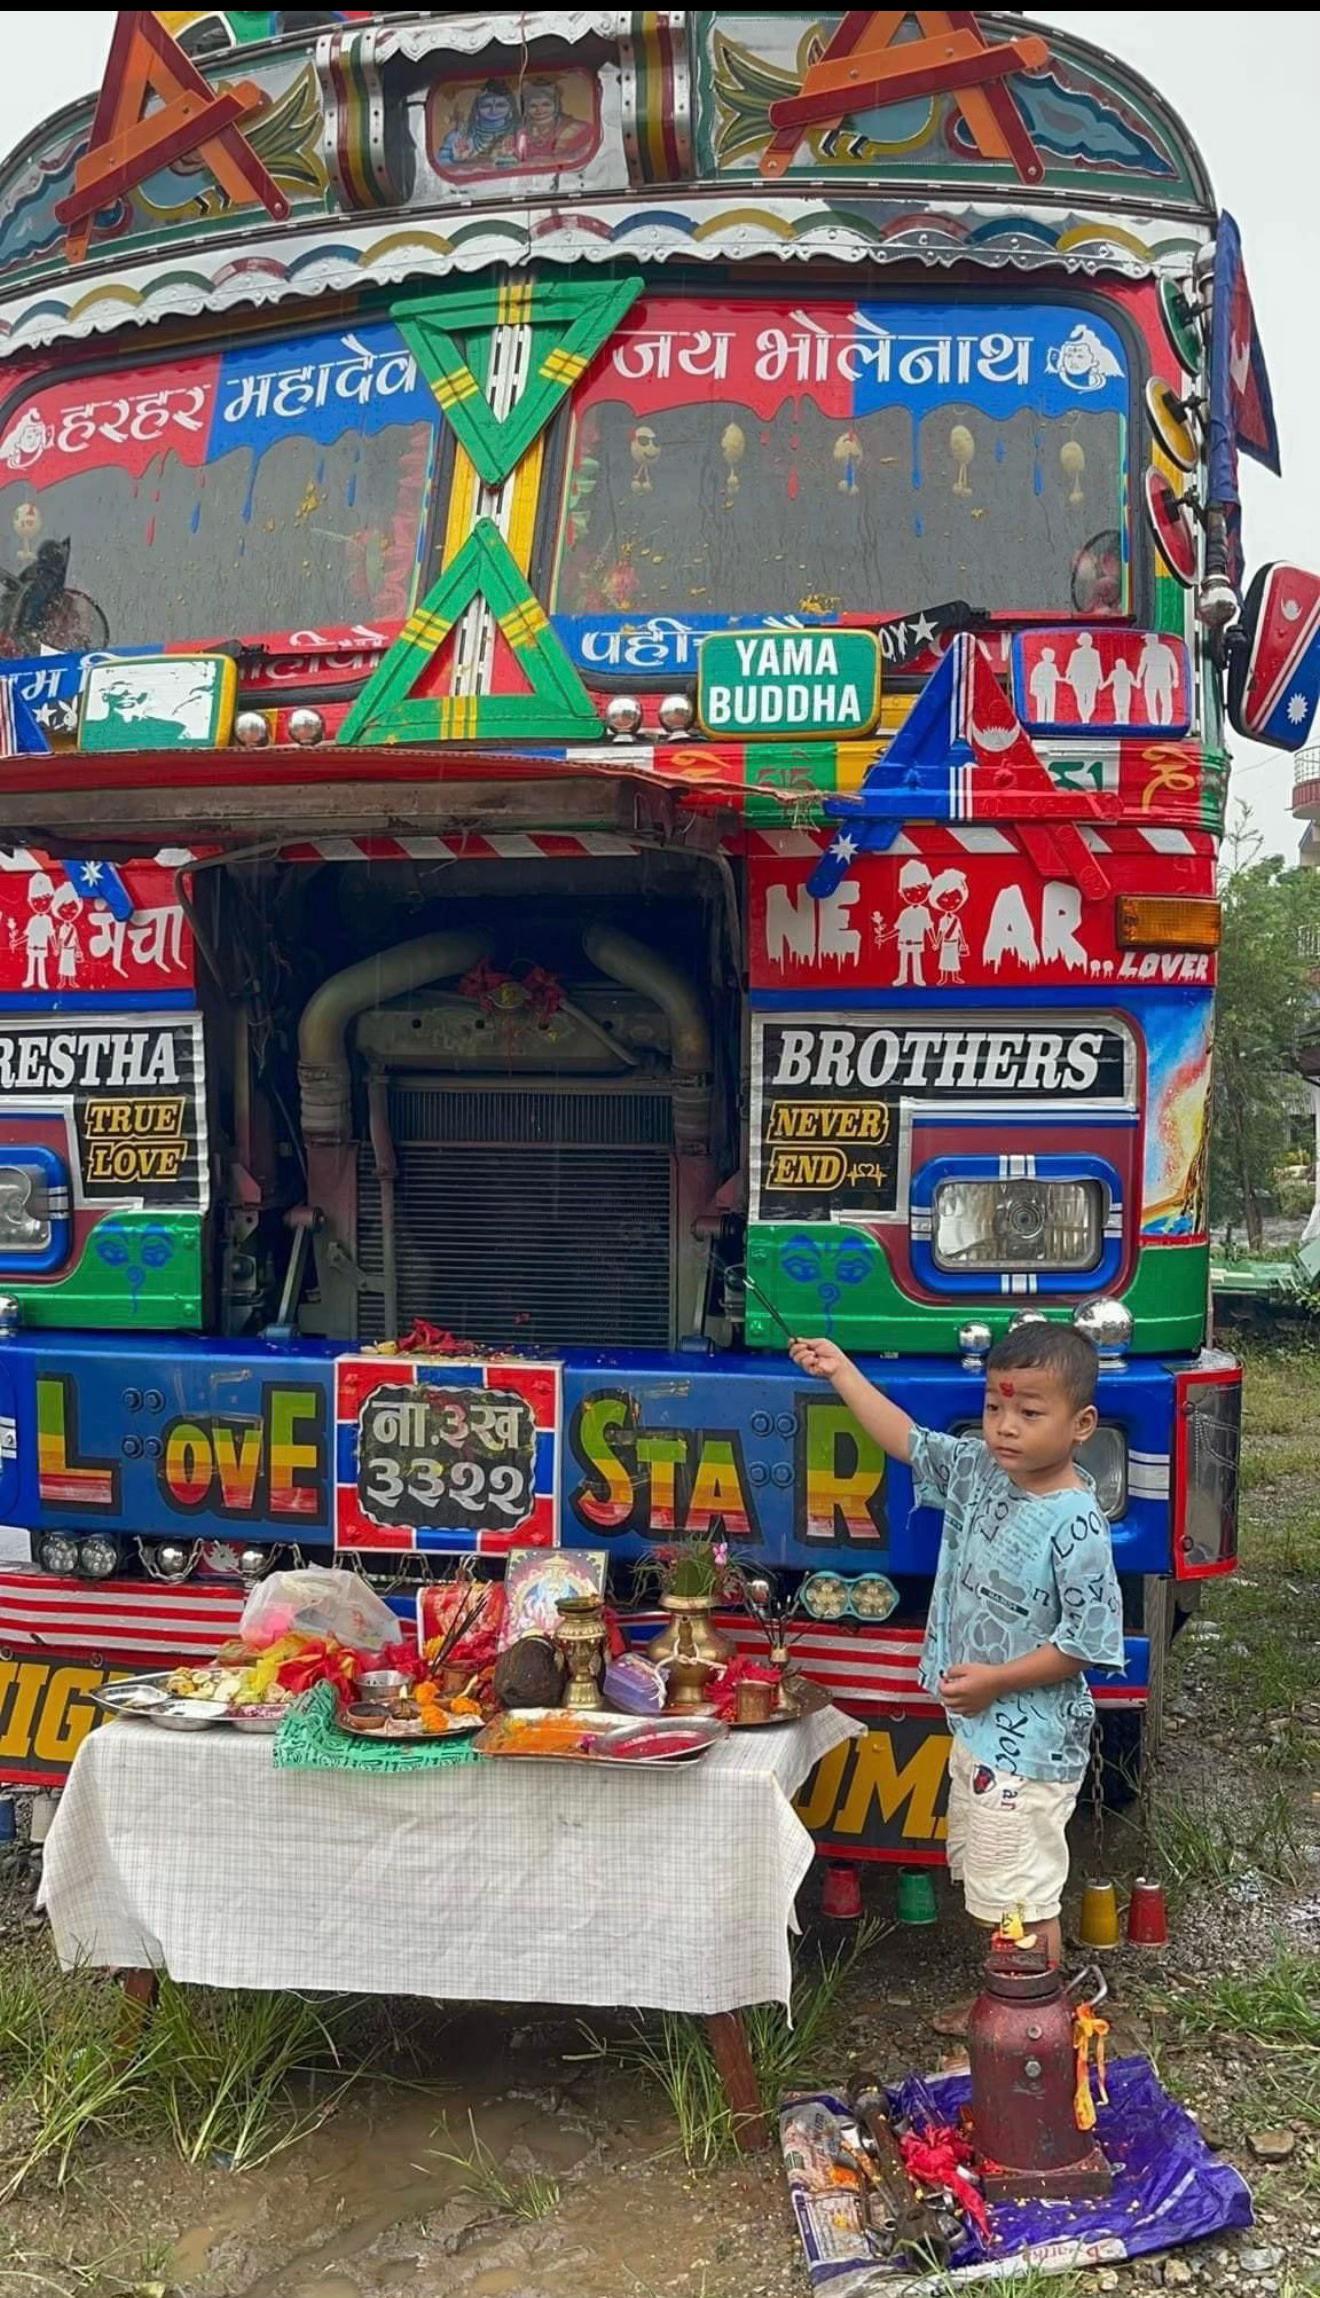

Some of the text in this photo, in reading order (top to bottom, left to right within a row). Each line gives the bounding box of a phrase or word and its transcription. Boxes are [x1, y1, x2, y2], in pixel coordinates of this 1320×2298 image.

[611, 310, 1035, 386] जय भोलेनाथ
[223, 333, 418, 423] महादेव
[734, 638, 839, 677] YAMA
[708, 684, 861, 724] BUDDHA
[1116, 951, 1209, 981] LOVER
[772, 1029, 1103, 1091] BROTHERS
[89, 1104, 178, 1134] TRUE
[772, 1107, 883, 1139] NEVER
[92, 1148, 181, 1177] LOVE
[772, 1152, 842, 1185] END
[366, 1457, 526, 1516] ३३२२
